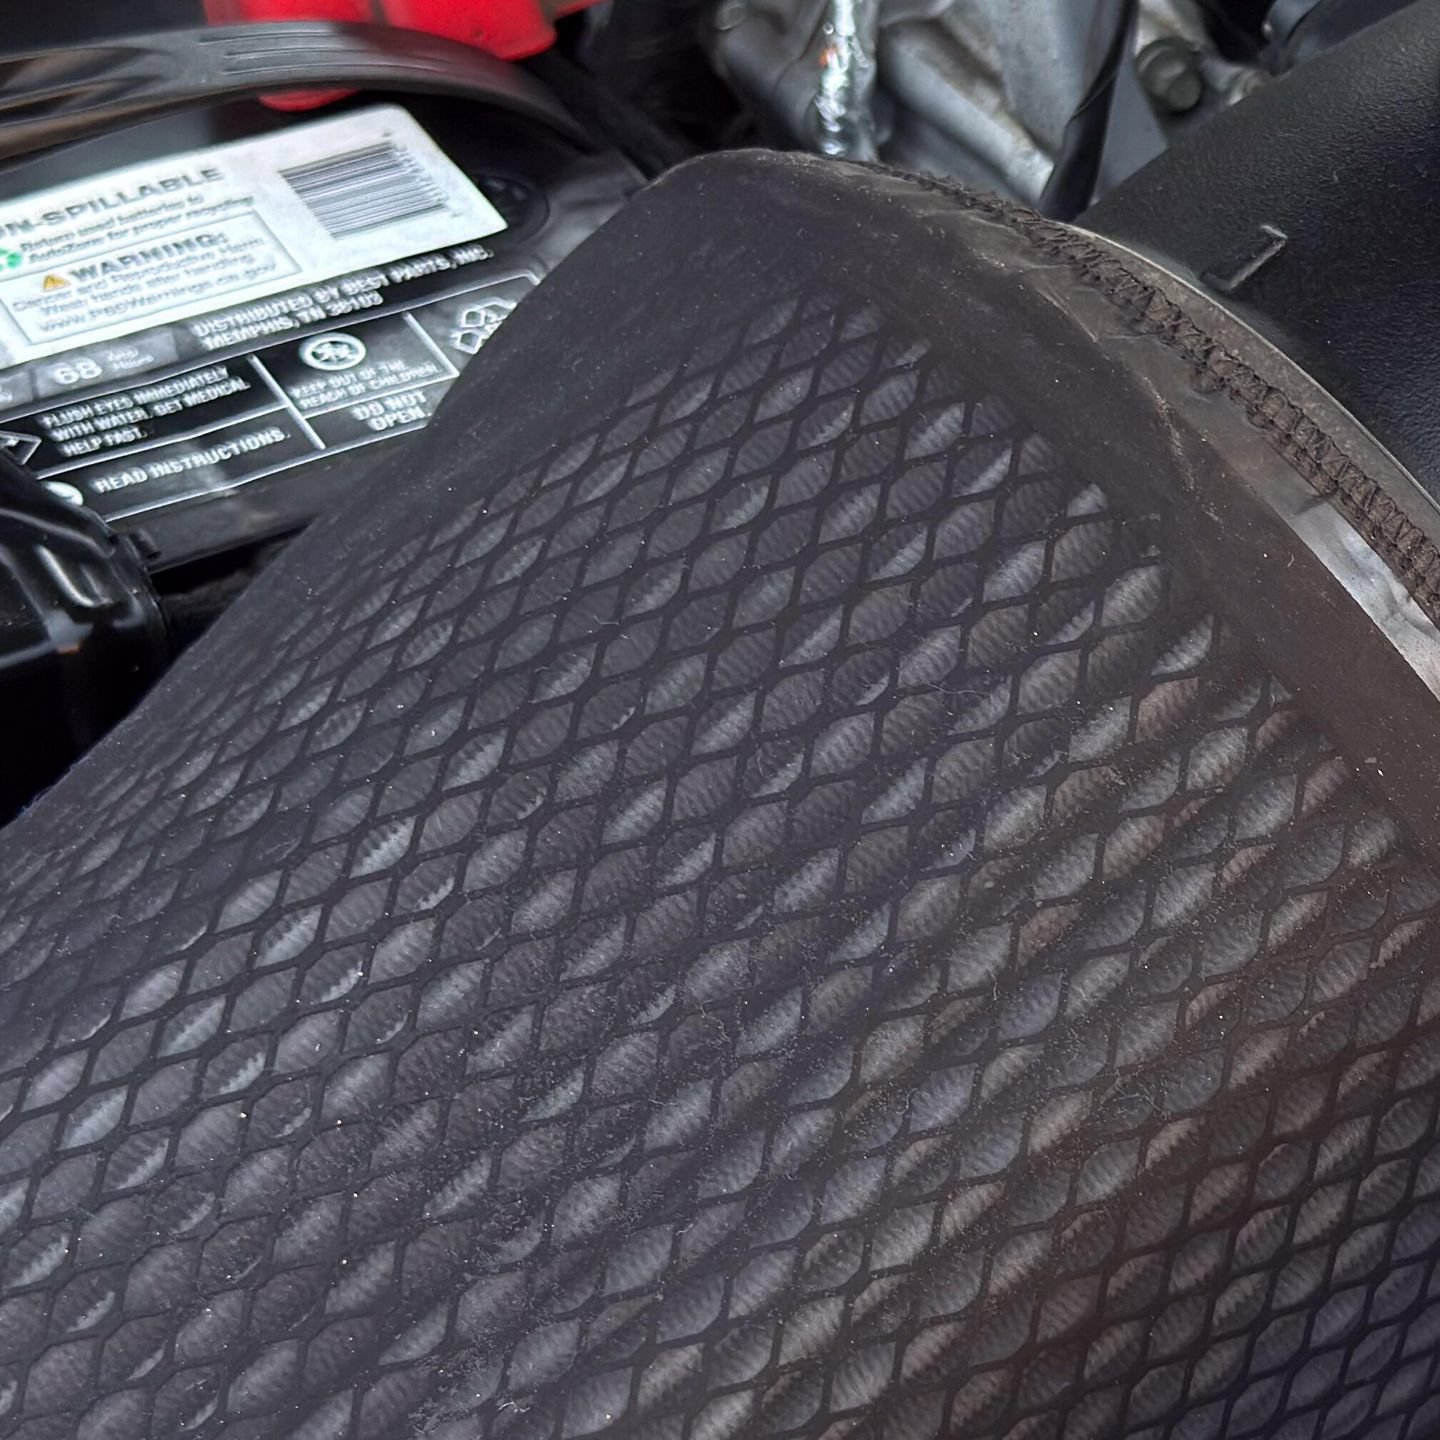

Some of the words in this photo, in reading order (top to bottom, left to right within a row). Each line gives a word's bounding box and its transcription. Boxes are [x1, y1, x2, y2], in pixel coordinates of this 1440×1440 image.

[70, 231, 229, 282] WARNING:
[191, 291, 312, 337] DISTRIBUTED
[53, 358, 103, 385] 68
[134, 365, 229, 404] IMMEDIATELY
[351, 402, 385, 421] DO
[386, 389, 427, 408] NOT
[91, 470, 148, 494] READ
[150, 426, 291, 479] INSTRUCTIONS.
